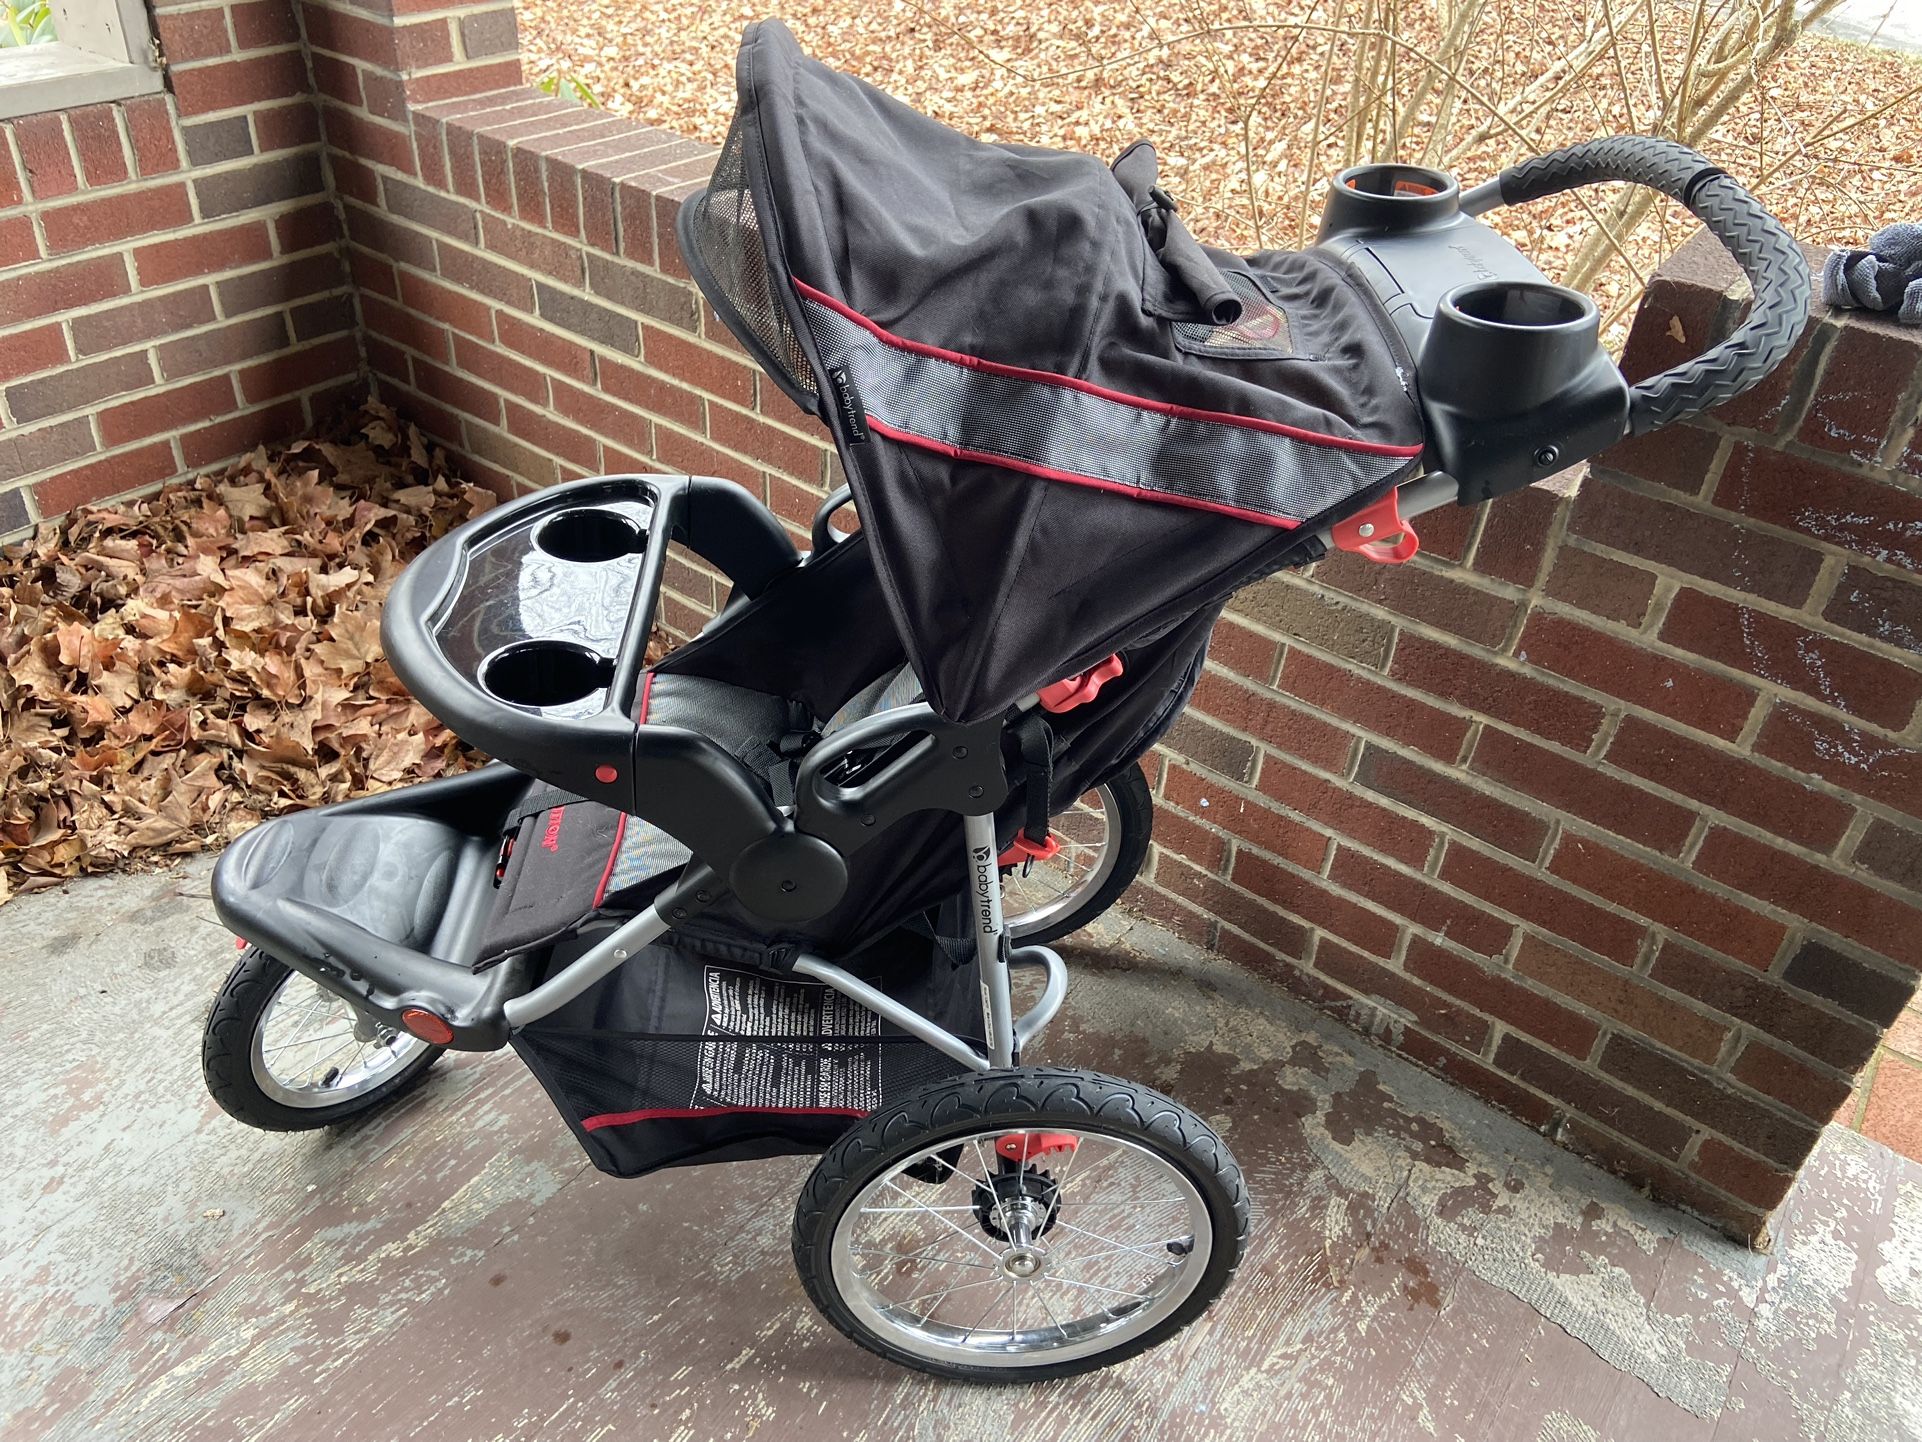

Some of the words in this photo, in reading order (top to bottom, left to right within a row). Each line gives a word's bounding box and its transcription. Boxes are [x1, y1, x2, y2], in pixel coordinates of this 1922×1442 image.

[839, 384, 864, 437] babytrend
[976, 864, 998, 934] babytrend
[709, 972, 721, 1013] ADVERTENCIA
[821, 988, 835, 1036] DVERTENCIA
